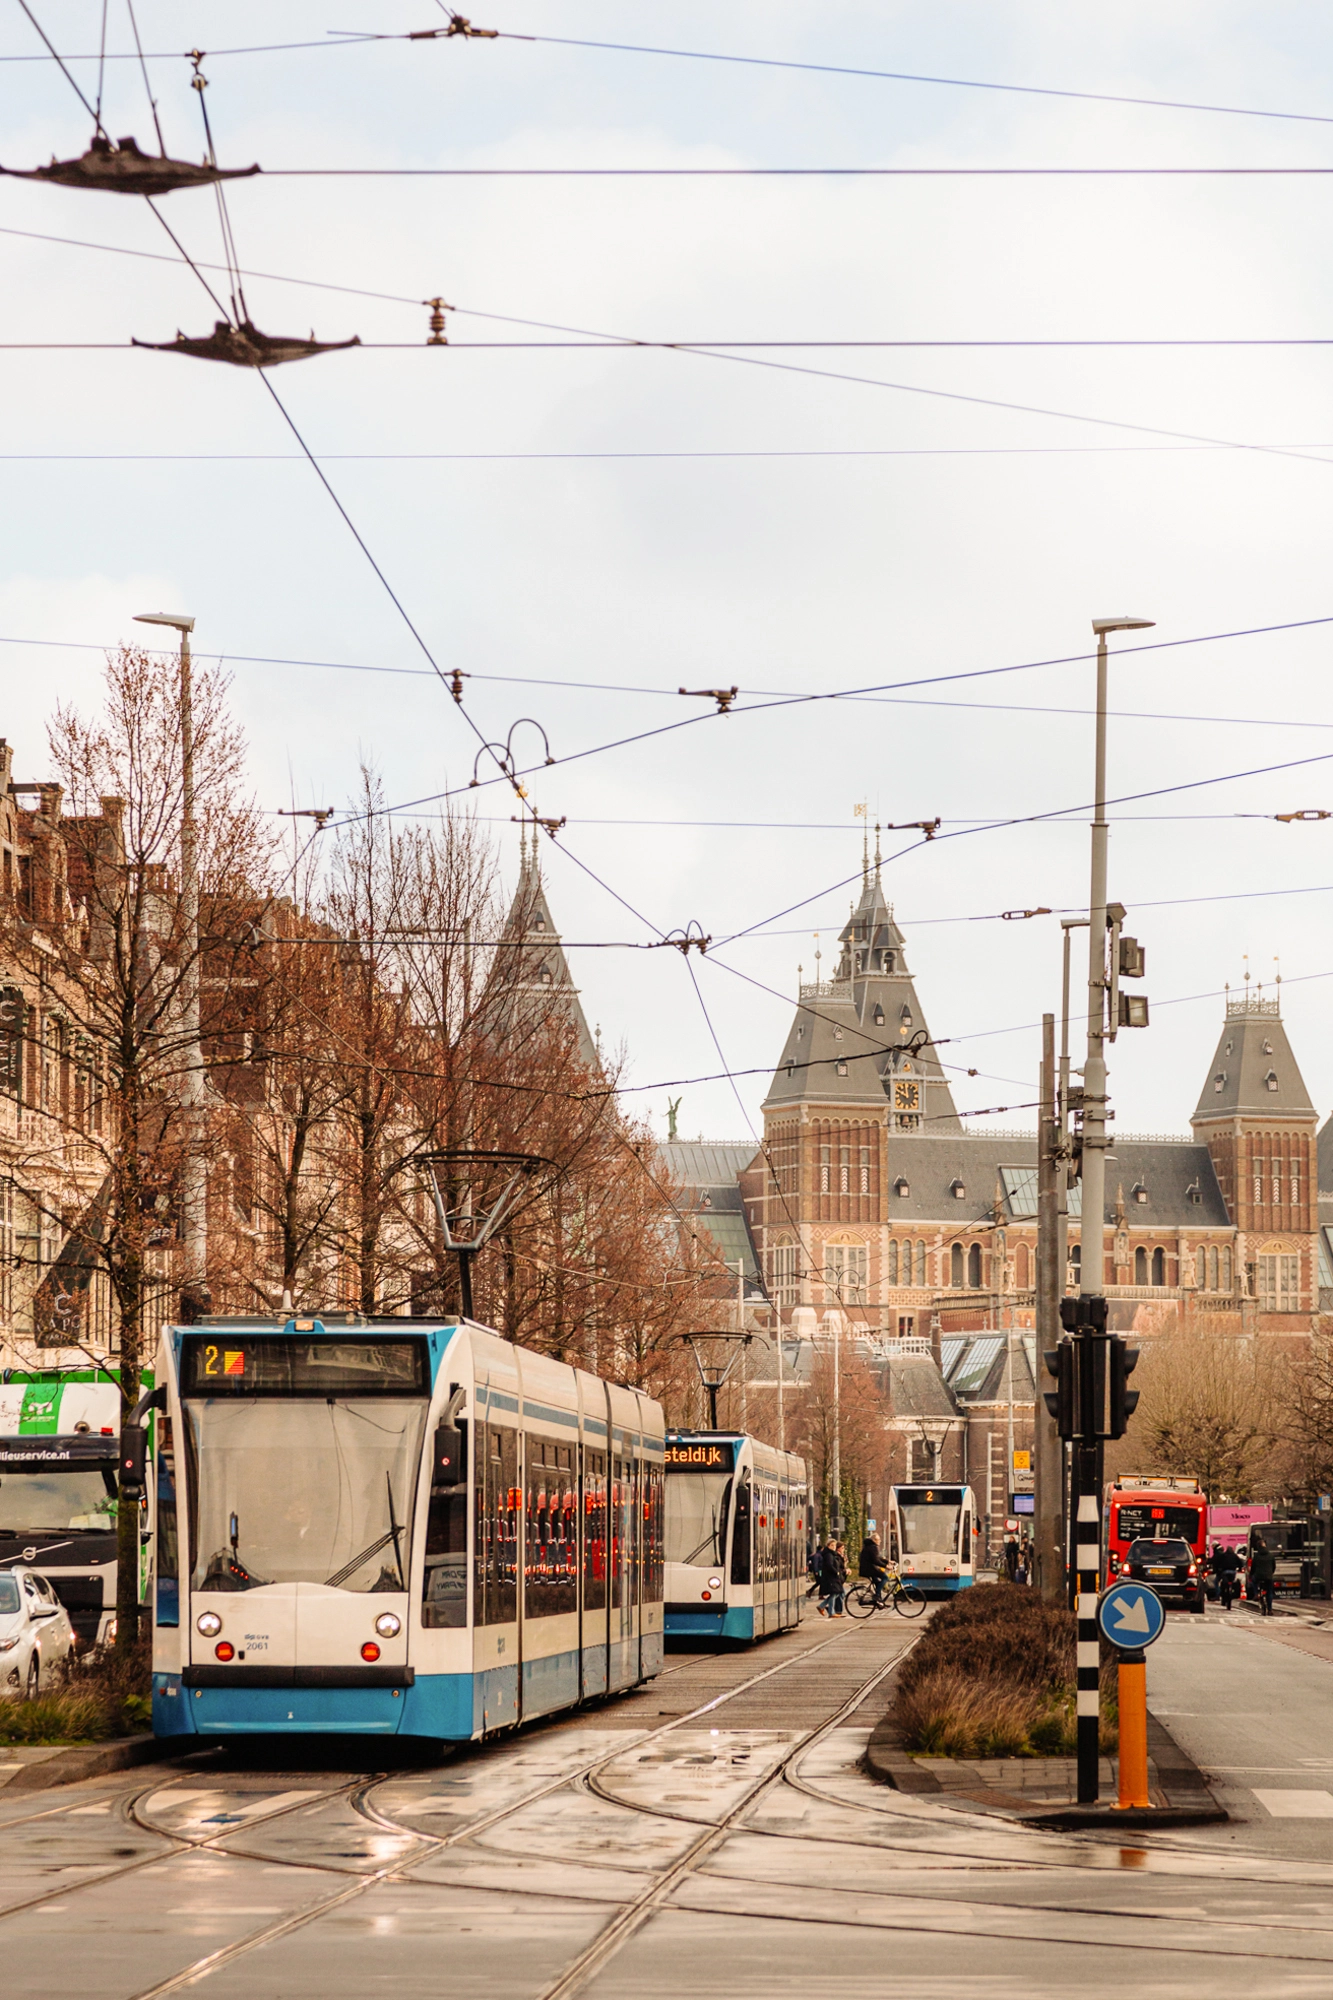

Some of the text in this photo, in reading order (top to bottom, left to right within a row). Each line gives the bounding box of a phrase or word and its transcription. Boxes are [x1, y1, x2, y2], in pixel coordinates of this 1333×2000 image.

[205, 1345, 218, 1375] 2
[664, 1446, 721, 1466] steldijk
[926, 1490, 933, 1502] 2
[246, 1642, 268, 1650] 2061
